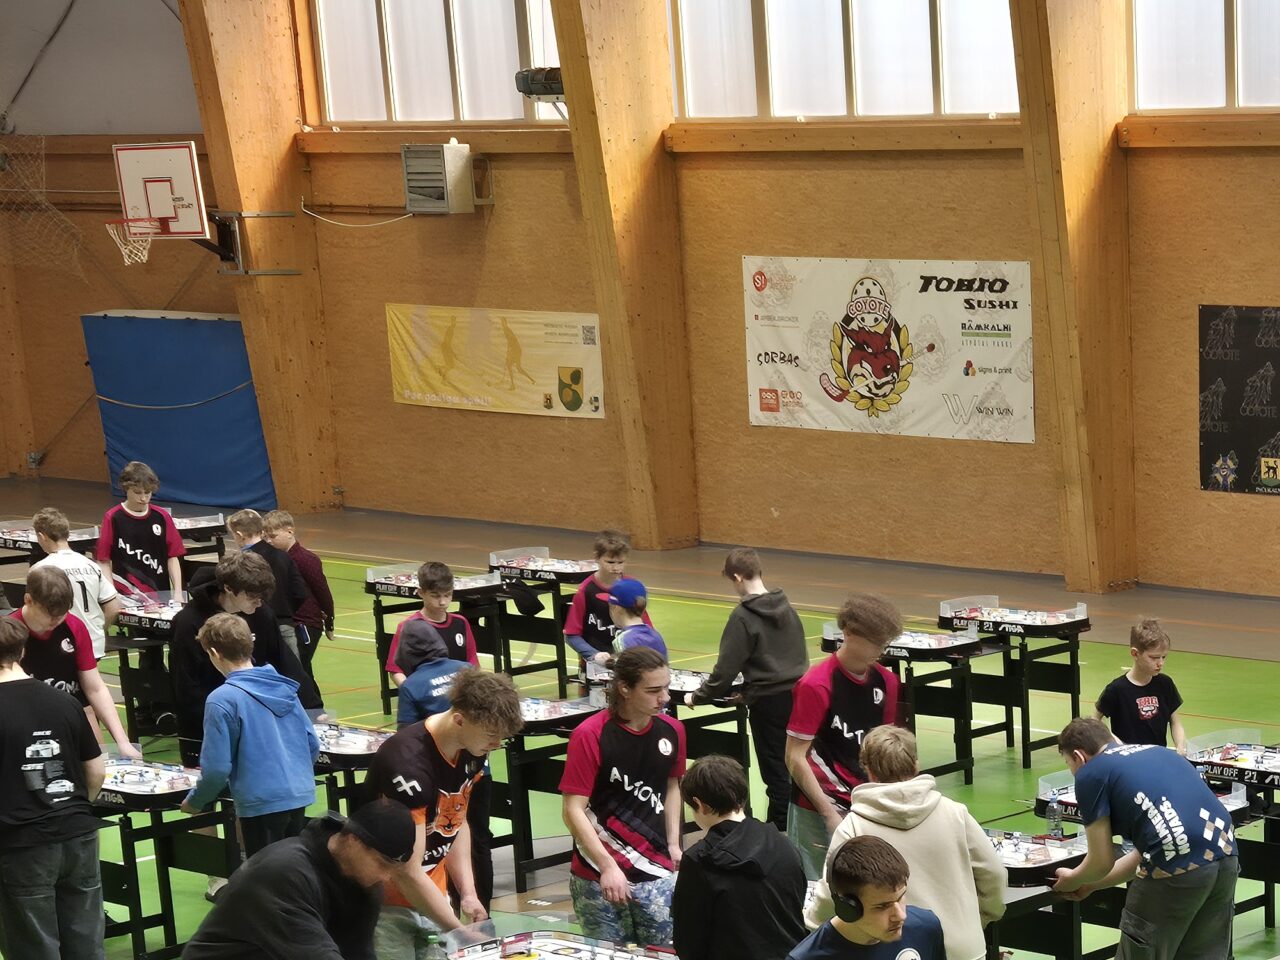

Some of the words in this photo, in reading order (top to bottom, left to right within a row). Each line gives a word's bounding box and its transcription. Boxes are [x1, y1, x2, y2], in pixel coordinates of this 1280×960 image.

[848, 298, 890, 317] COYOTE
[963, 298, 1019, 311] SUSHI
[1203, 349, 1240, 361] COYOTE
[975, 406, 994, 416] WIN
[996, 407, 1014, 417] WIN
[1240, 406, 1278, 418] COYOTE
[118, 538, 164, 575] ALTONA
[76, 581, 90, 613] 1
[588, 613, 622, 637] ALT
[983, 622, 993, 631] 21
[999, 623, 1025, 633] STIGA
[831, 714, 865, 745] ALT
[1203, 763, 1221, 775] PLAY
[1223, 766, 1239, 778] OFF
[1244, 770, 1258, 783] 21
[609, 766, 665, 815] ALTONA
